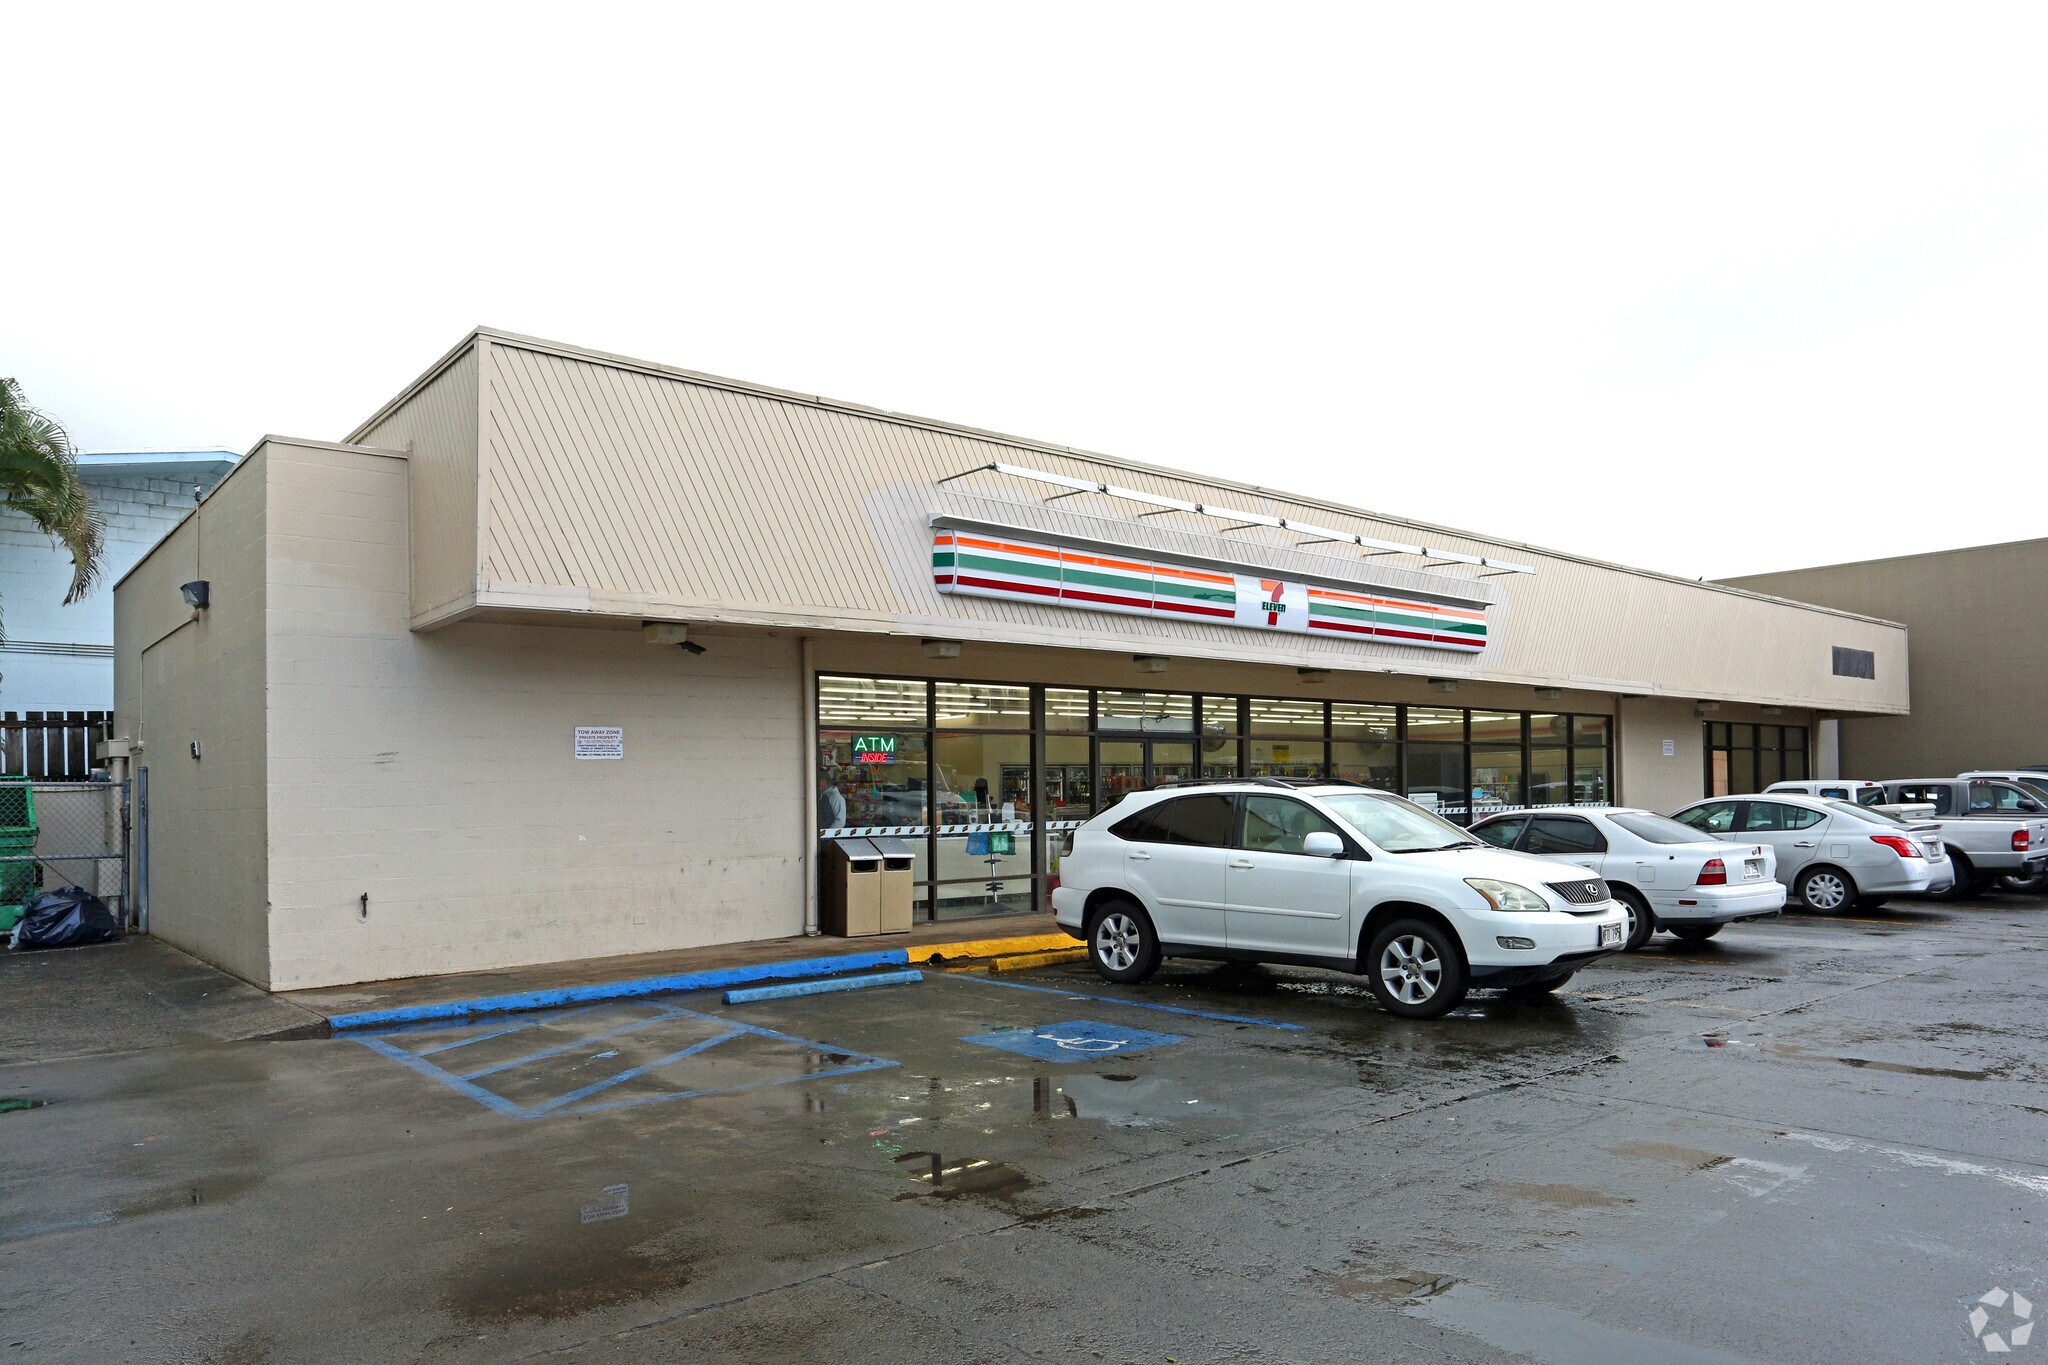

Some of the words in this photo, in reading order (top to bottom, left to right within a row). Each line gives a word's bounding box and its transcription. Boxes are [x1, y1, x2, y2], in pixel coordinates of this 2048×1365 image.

[1260, 579, 1285, 626] 7
[854, 737, 894, 752] ATM
[860, 752, 888, 763] INSIDE
